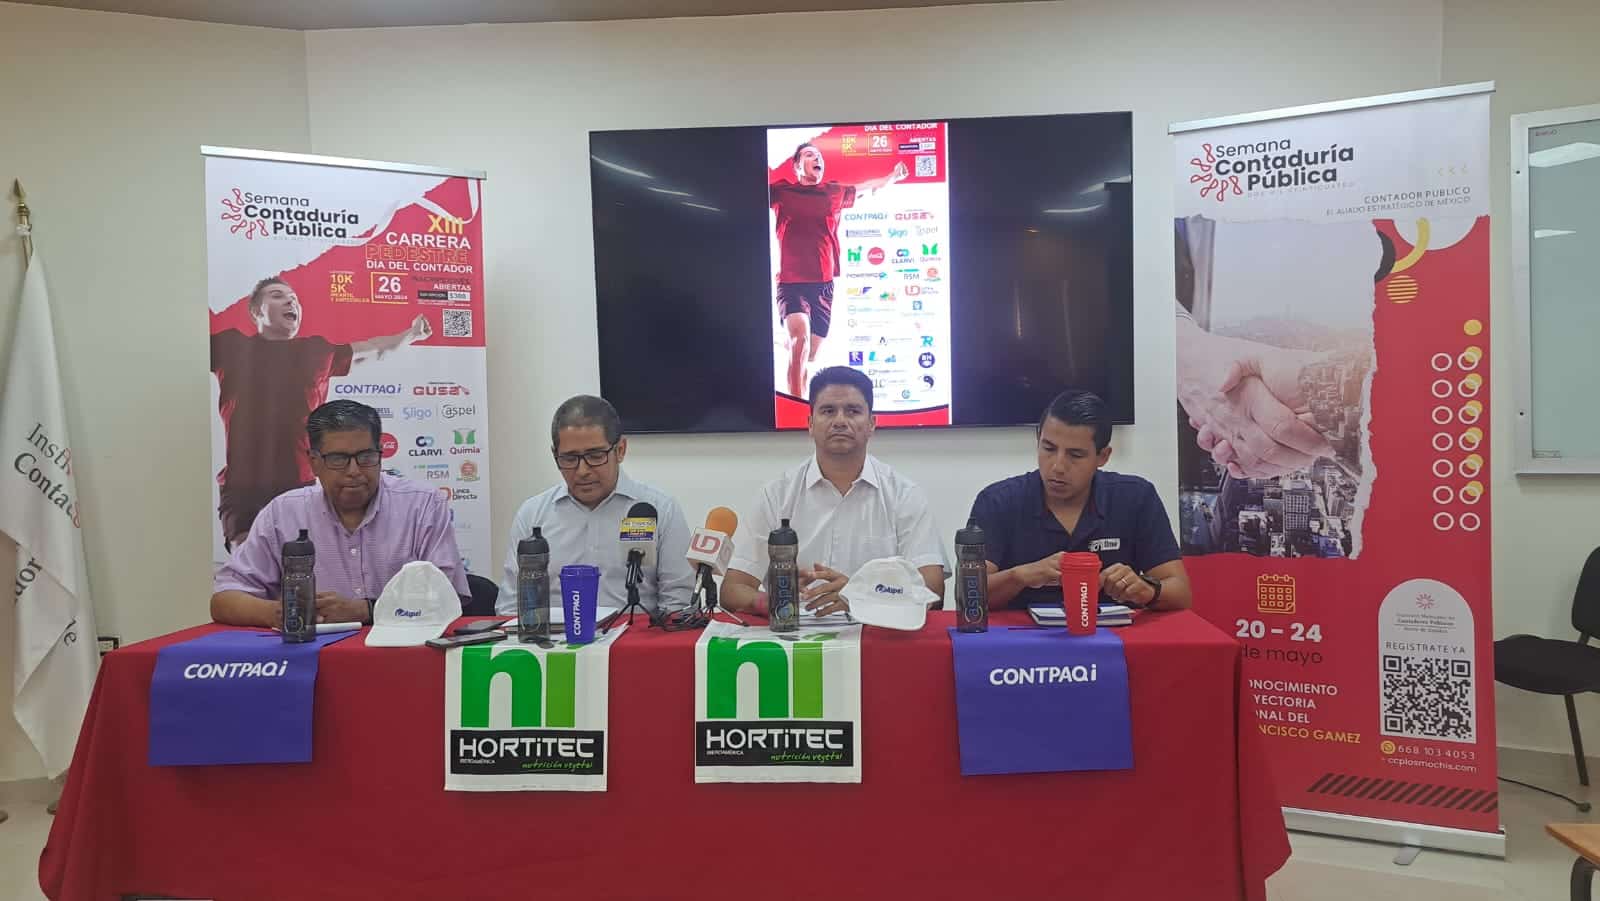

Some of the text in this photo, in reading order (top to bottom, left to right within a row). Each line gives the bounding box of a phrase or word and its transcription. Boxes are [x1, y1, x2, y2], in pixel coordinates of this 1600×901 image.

[872, 136, 887, 148] 26
[1216, 139, 1291, 158] Semana
[1215, 144, 1354, 176] Contaduría
[1247, 167, 1337, 191] Pública
[244, 192, 309, 207] Semana
[1364, 191, 1422, 204] CONTADOR
[244, 205, 359, 225] Contaduría
[272, 220, 347, 239] Pública
[386, 232, 471, 249] CARRERA
[366, 244, 467, 264] PEDESTRE
[388, 261, 409, 271] DEL
[413, 262, 473, 274] CONTADOR
[331, 274, 353, 284] 10K
[378, 276, 401, 293] 26
[331, 285, 346, 293] 5K
[433, 283, 472, 291] ABIERTAS
[335, 384, 401, 395] CONTPAQi
[441, 404, 476, 419] aspel
[409, 449, 442, 457] CLARVI
[449, 447, 480, 455] Quimia
[427, 470, 449, 480] RSM
[963, 575, 984, 625] aspel
[1080, 582, 1088, 628] CONTPAQi
[572, 590, 581, 636] CONTPAQi
[1235, 619, 1266, 638] 20
[1290, 623, 1323, 643] 24
[1385, 641, 1449, 654] REGISTRATE
[1267, 647, 1323, 668] mayo
[184, 660, 288, 680] CONTPAQi
[989, 664, 1097, 686] CONTPAQi
[1288, 711, 1310, 724] DEL
[1313, 730, 1361, 744] GAMEZ
[1398, 745, 1420, 754] 668
[1445, 750, 1475, 760] 4053
